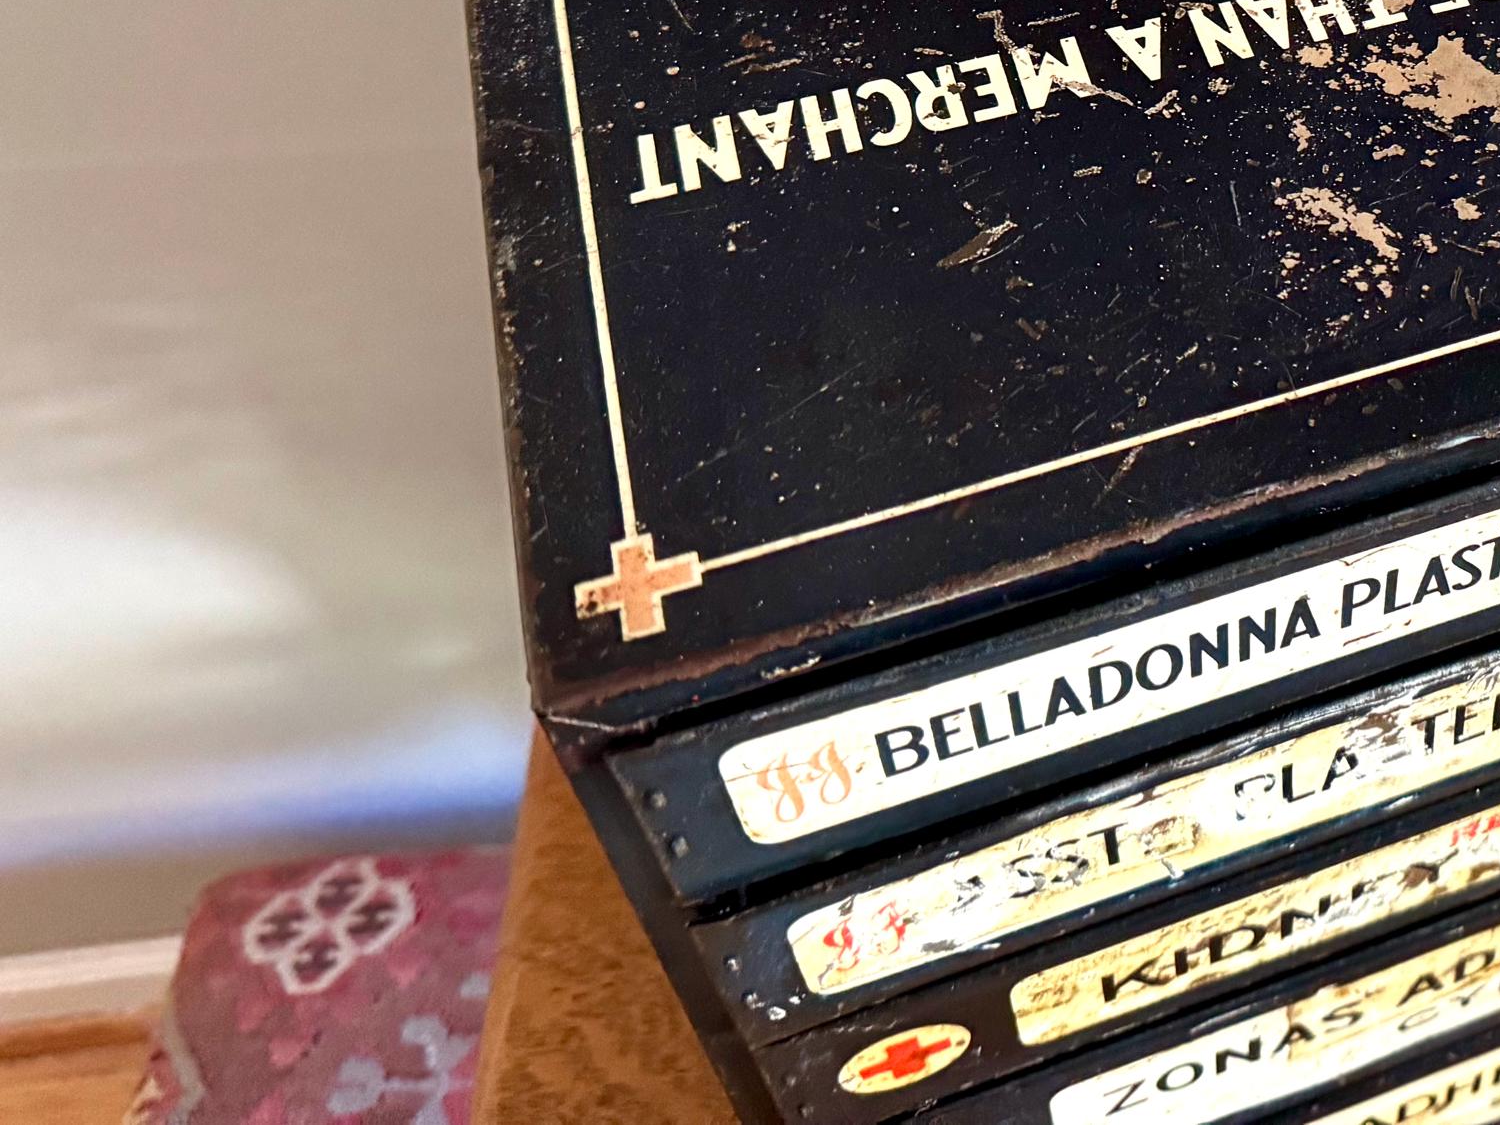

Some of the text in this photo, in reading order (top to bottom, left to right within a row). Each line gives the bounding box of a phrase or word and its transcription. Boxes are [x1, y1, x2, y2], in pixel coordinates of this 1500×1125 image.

[629, 35, 1101, 205] MERCHANT
[1105, 17, 1163, 82] A
[874, 595, 1321, 779] BELLADONNA
[1102, 997, 1364, 1118] ZONAS
